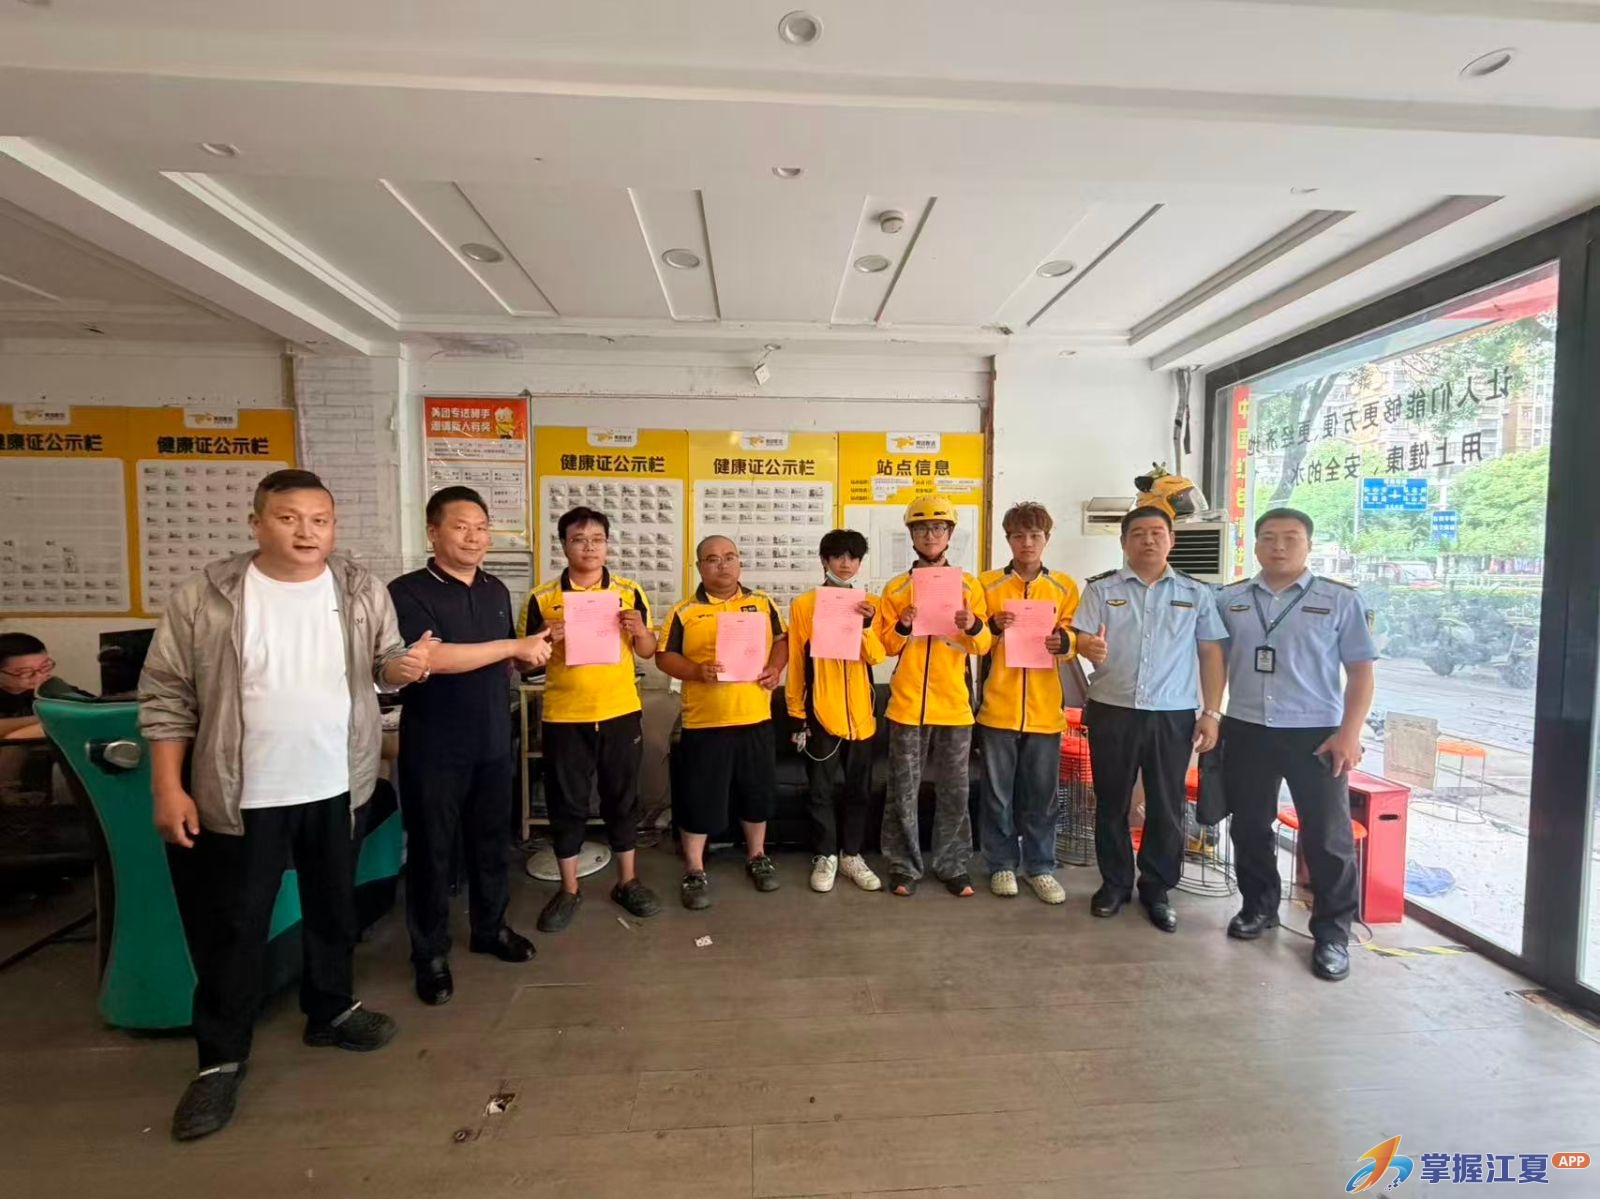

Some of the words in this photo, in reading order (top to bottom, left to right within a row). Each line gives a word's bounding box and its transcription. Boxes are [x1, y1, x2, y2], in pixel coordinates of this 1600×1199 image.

[157, 436, 270, 455] 健康证公示栏
[560, 454, 666, 473] 健康证公示栏
[713, 458, 816, 476] 健康证公示栏
[876, 459, 951, 476] 站点信息
